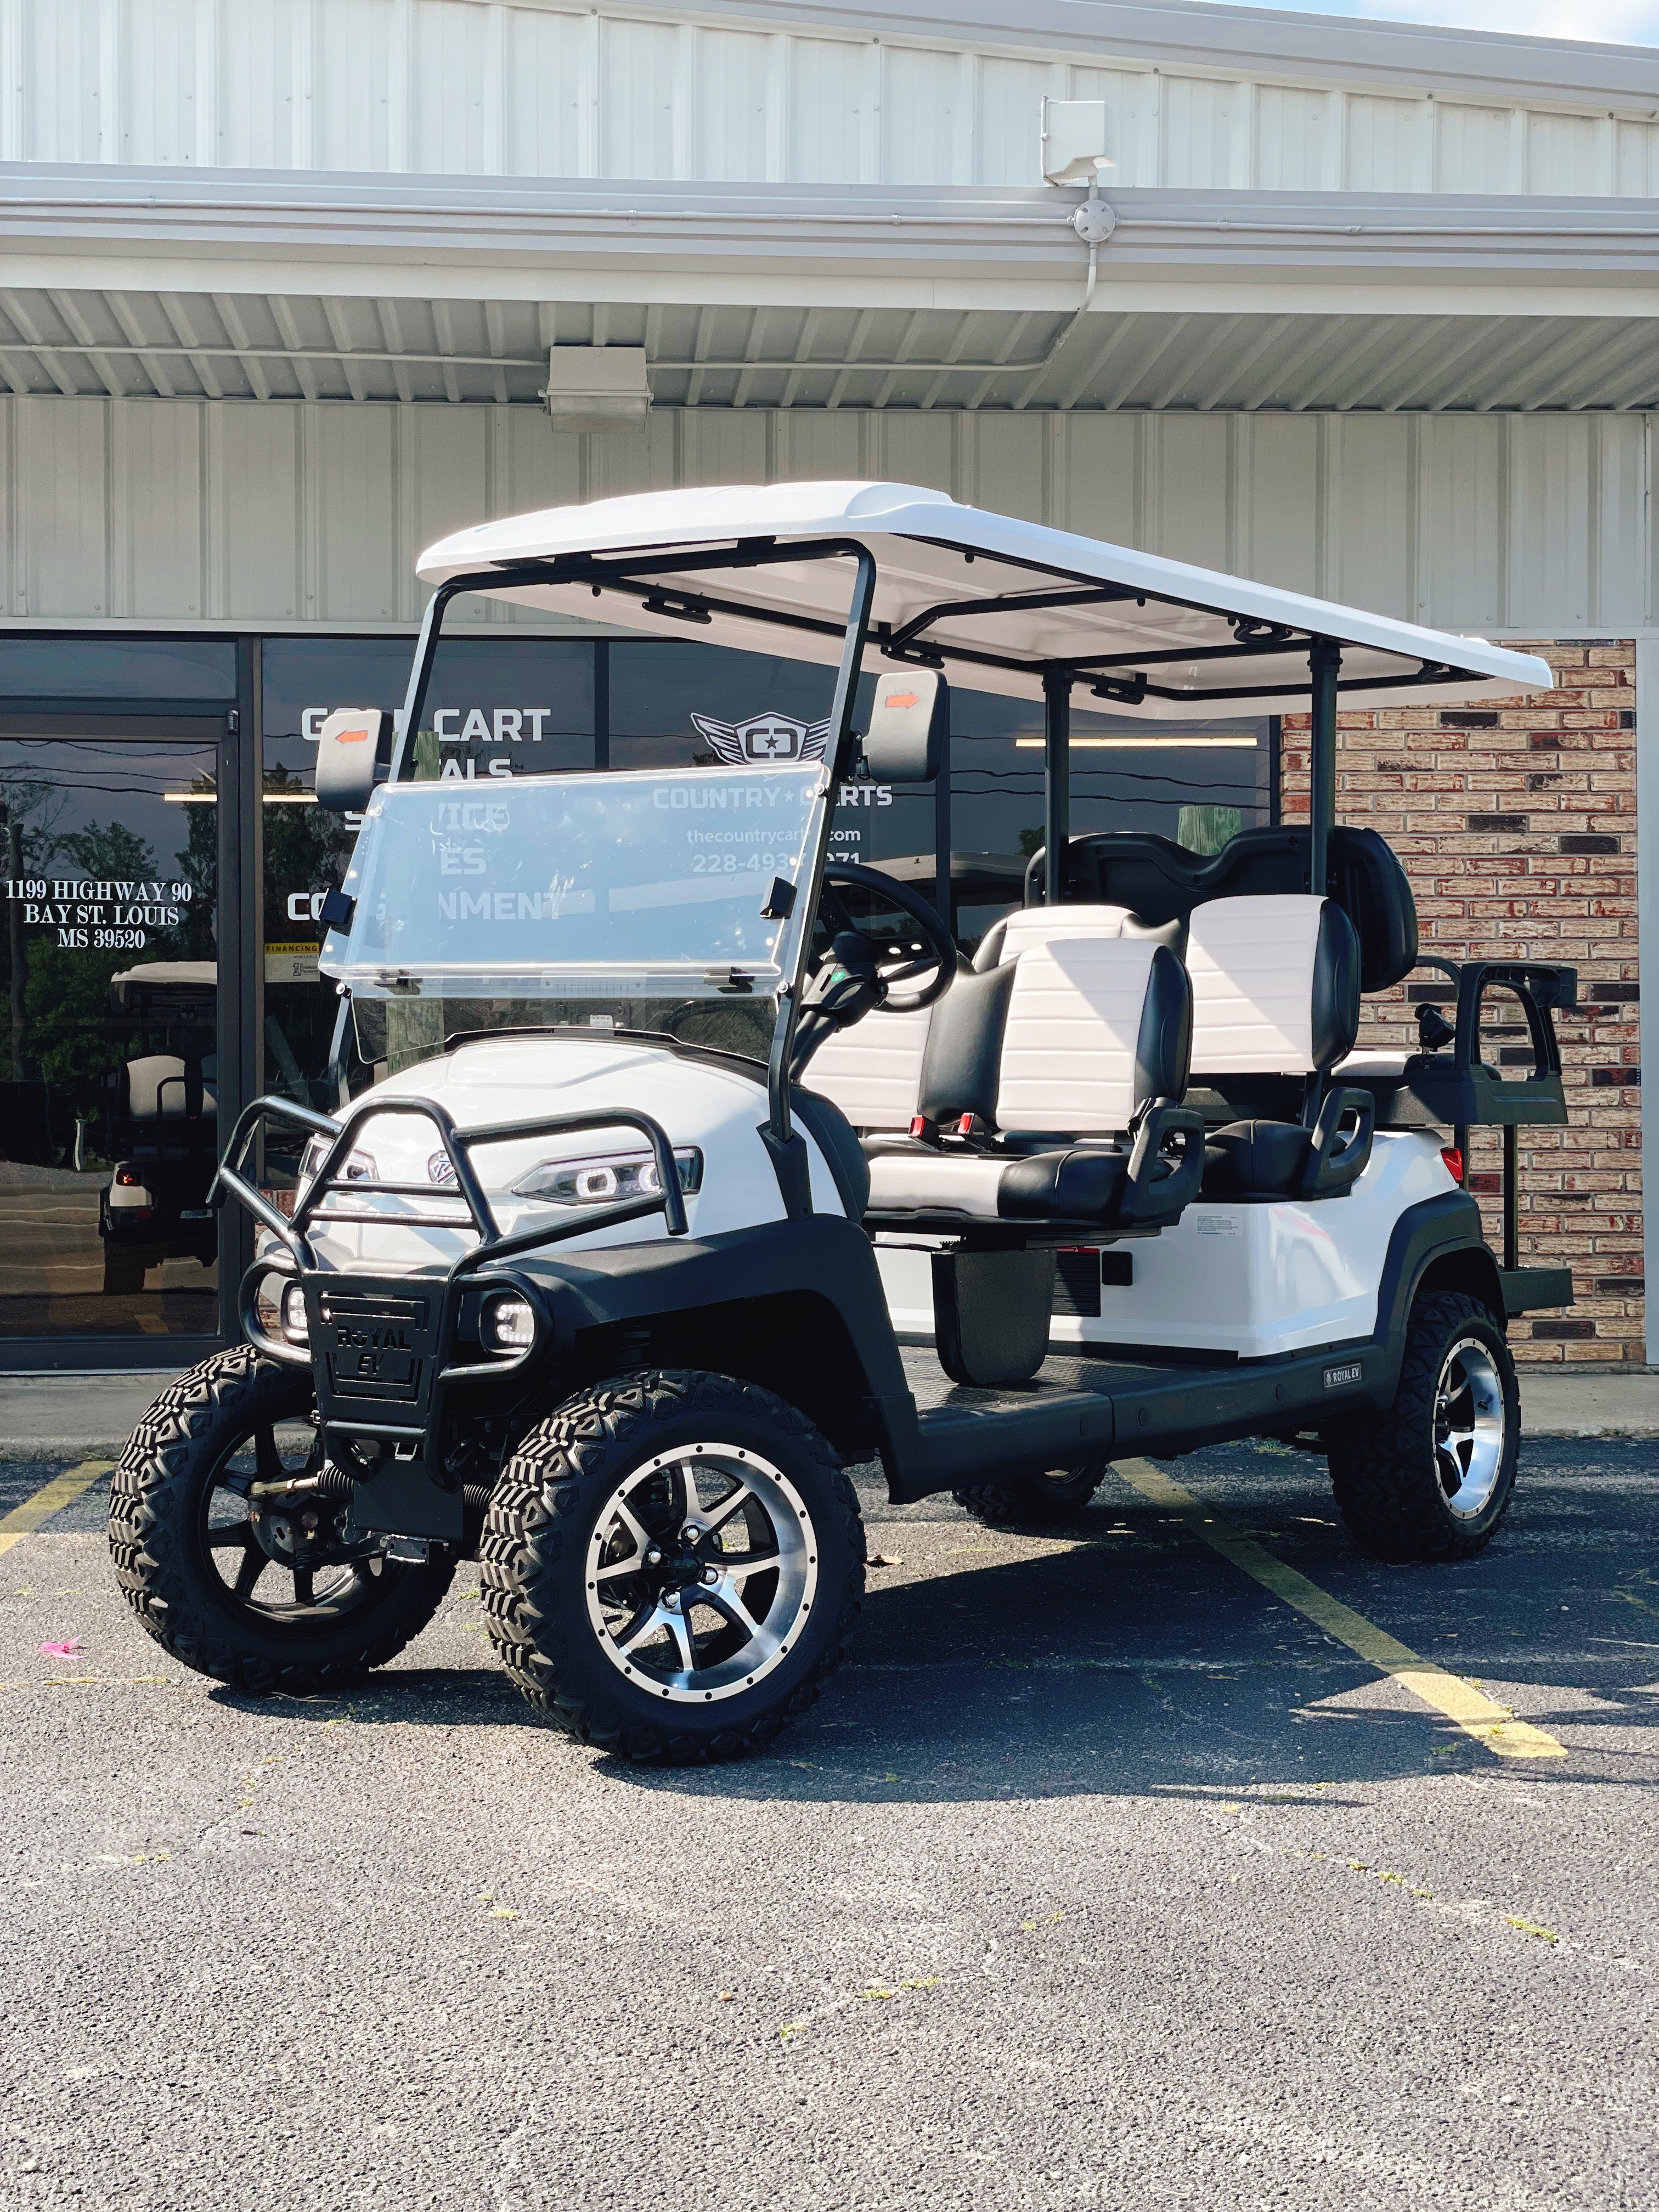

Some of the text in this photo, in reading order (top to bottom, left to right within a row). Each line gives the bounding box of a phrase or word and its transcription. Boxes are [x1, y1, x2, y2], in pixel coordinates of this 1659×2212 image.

[434, 708, 551, 741] CART
[653, 785, 893, 809] COUNTRY CRTS
[5, 879, 192, 902] 1199 HIGHWAY 90
[24, 904, 179, 926] BAY ST. LOUIS
[57, 928, 145, 949] MS 39520
[337, 1325, 411, 1351] ROYAL
[357, 1352, 386, 1375] EV
[1333, 1367, 1359, 1383] ROYAL EV
